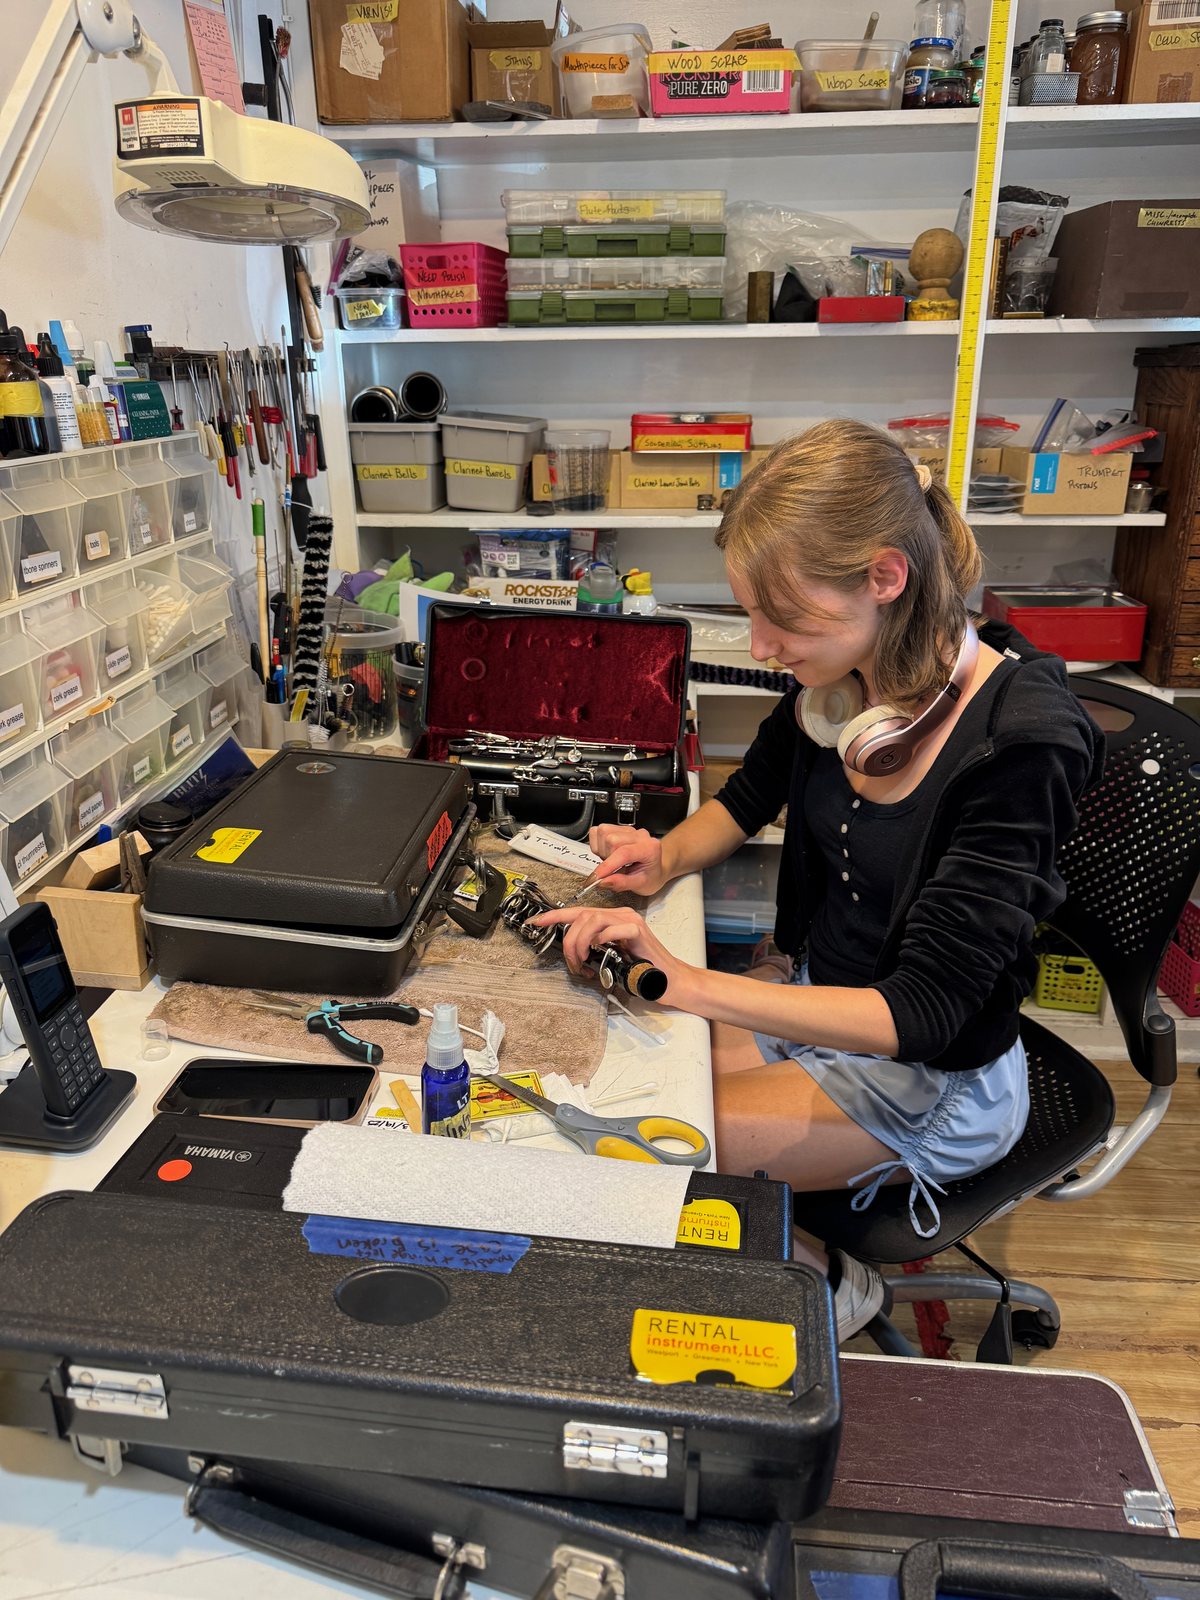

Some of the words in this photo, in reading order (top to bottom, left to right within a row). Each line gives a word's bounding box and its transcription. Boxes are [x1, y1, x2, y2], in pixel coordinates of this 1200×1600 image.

[667, 54, 702, 70] WOOD
[711, 54, 748, 70] SCRAPS
[670, 82, 699, 95] PURE
[701, 81, 728, 95] ZERO
[362, 467, 393, 479] Clarinet
[395, 467, 418, 480] Bells
[453, 462, 484, 475] Clarinet
[1077, 464, 1126, 477] TRUMPET
[1067, 480, 1098, 490] PISTONS
[513, 597, 545, 606] ENERGY
[546, 598, 572, 607] DRINK
[53, 691, 64, 704] cork
[63, 685, 79, 698] grease
[7, 711, 24, 727] grease
[80, 807, 91, 820] sand
[184, 1144, 236, 1160] YAMAHA
[337, 1235, 405, 1251] broken
[649, 1317, 740, 1341] RENTAL
[647, 1349, 680, 1358] Westport
[693, 1353, 732, 1363] Greenwich
[745, 1359, 761, 1367] New
